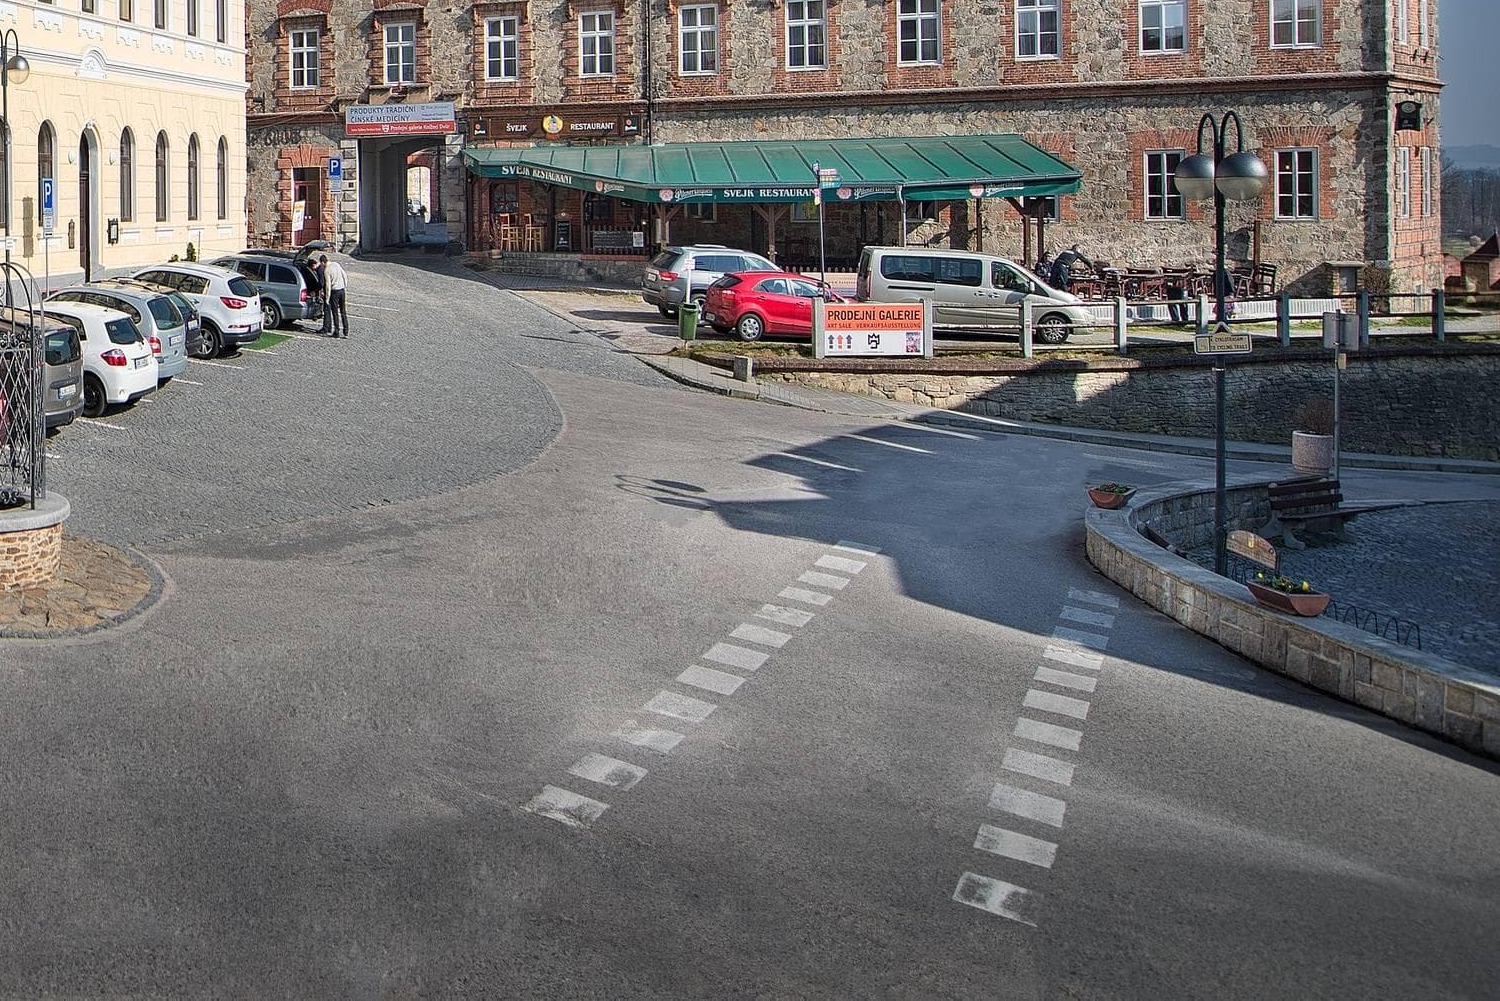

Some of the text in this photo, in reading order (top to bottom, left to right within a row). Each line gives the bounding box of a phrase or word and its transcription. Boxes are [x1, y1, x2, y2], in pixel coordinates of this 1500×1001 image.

[350, 107, 384, 115] PRODUKTY
[386, 105, 416, 113] TRADIČNÍ
[350, 115, 374, 123] ČÍNSKÉ
[506, 122, 528, 132] ŠVEJK
[570, 122, 615, 131] RESTAURANT
[330, 160, 339, 173] P
[532, 168, 572, 185] RESTAURANT
[45, 182, 52, 204] P
[723, 188, 816, 198] SVEJK RESTAURAN
[828, 307, 921, 320] PRODEJNÍ GALERIE
